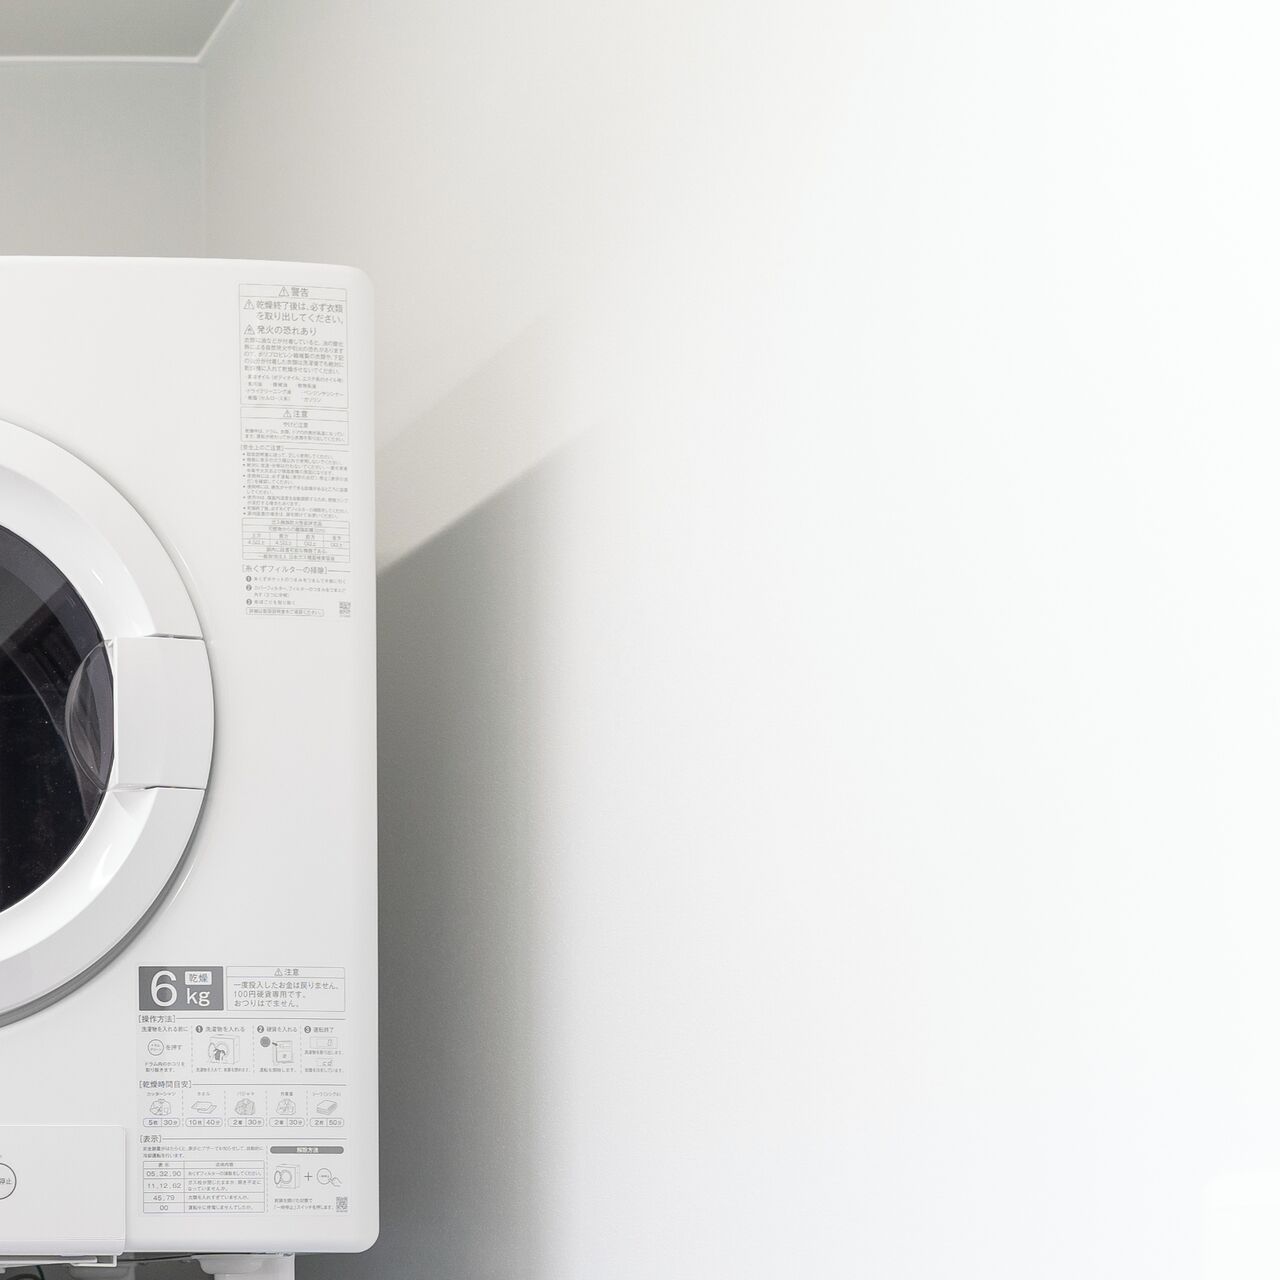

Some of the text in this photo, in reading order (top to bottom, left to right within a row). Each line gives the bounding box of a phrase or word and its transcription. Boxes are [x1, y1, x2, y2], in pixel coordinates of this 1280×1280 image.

[291, 288, 309, 297] 警告
[189, 973, 209, 983] 乾燥
[151, 971, 177, 1007] 6
[234, 982, 340, 990] 一度投入したお金は戻りません。
[186, 988, 210, 1006] kg
[234, 1000, 299, 1008] おつりはでません。
